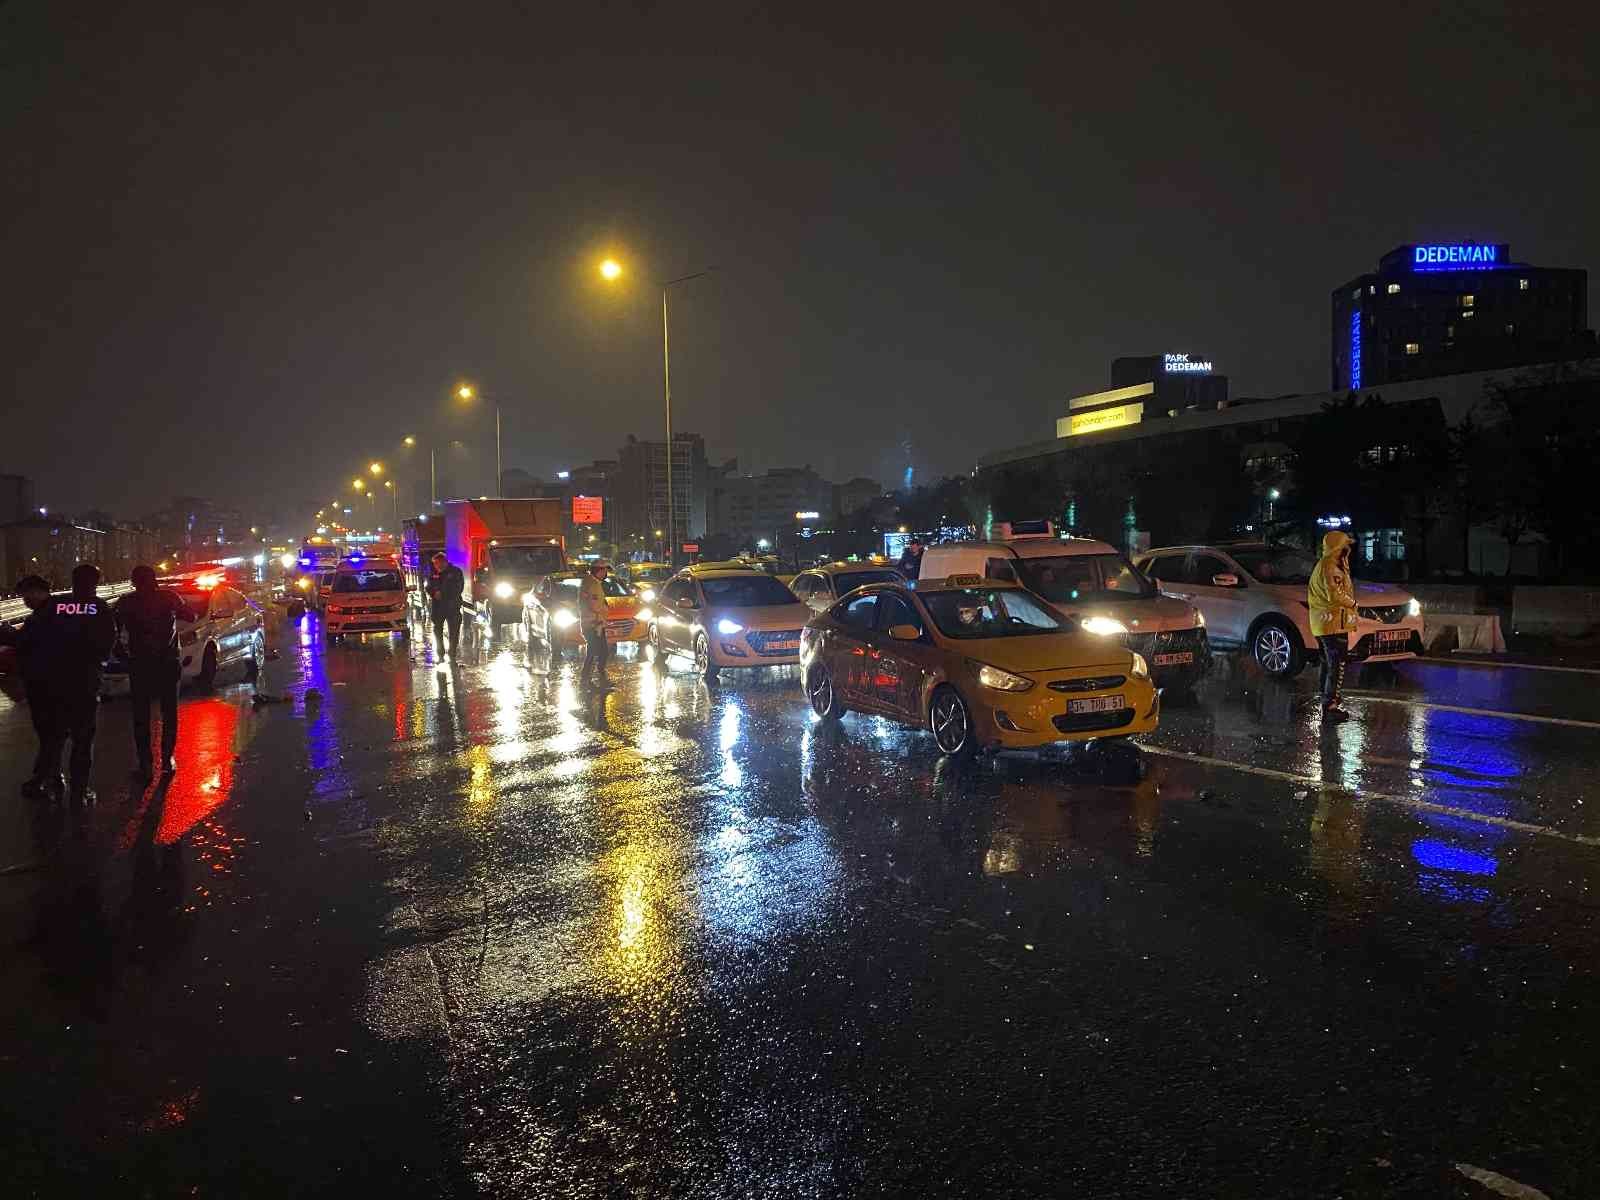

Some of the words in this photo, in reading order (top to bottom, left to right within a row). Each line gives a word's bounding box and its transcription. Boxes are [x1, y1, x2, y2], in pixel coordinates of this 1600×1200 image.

[1415, 246, 1496, 263] DEDEMAN
[1165, 353, 1189, 362] PARK
[1352, 311, 1362, 391] DEDEMAN
[1165, 362, 1212, 371] DEDEMAN
